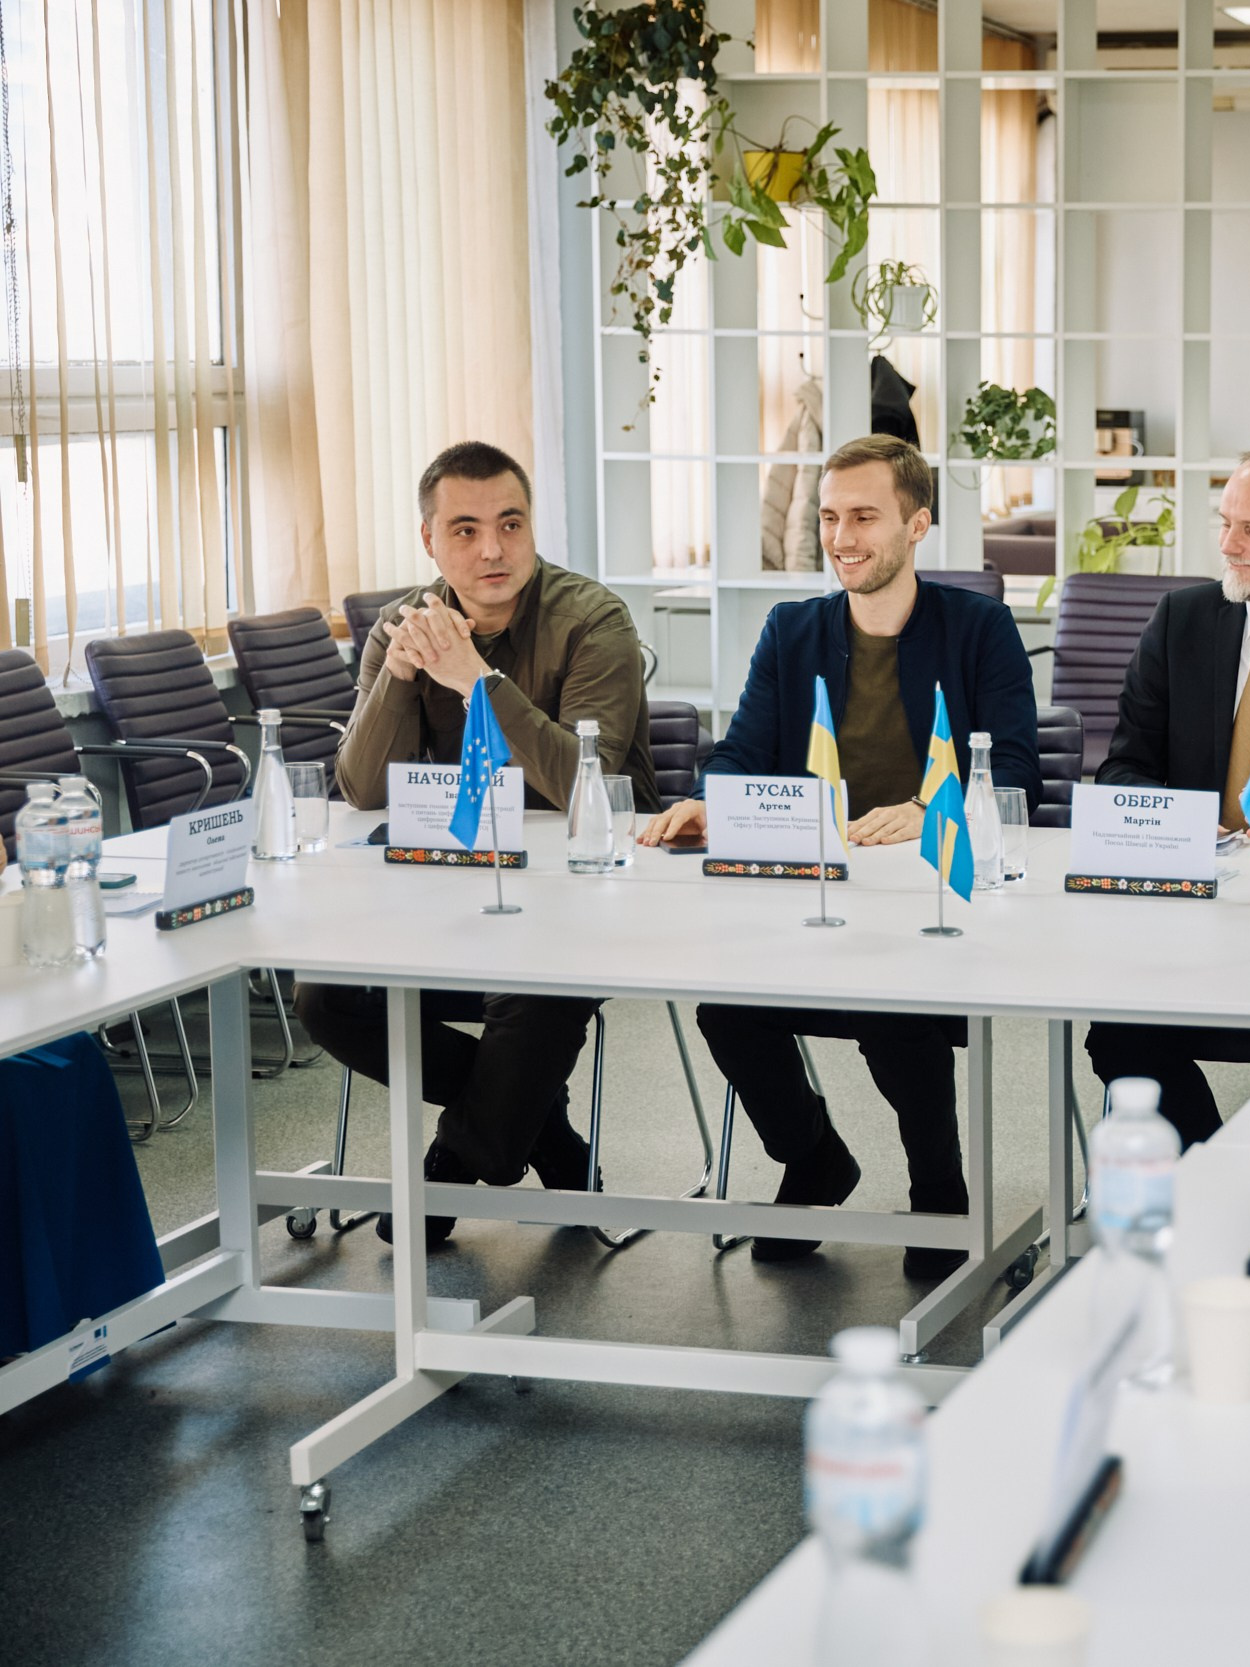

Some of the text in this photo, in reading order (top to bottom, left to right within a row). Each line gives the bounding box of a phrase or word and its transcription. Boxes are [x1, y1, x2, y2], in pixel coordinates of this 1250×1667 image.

[407, 770, 505, 787] НАЧОЙ
[744, 783, 805, 798] ГУСАК
[758, 802, 791, 812] Артем
[1113, 793, 1175, 810] ОБЕРГ
[188, 809, 244, 836] КРИШЕНЬ
[1123, 815, 1162, 827] Мартін
